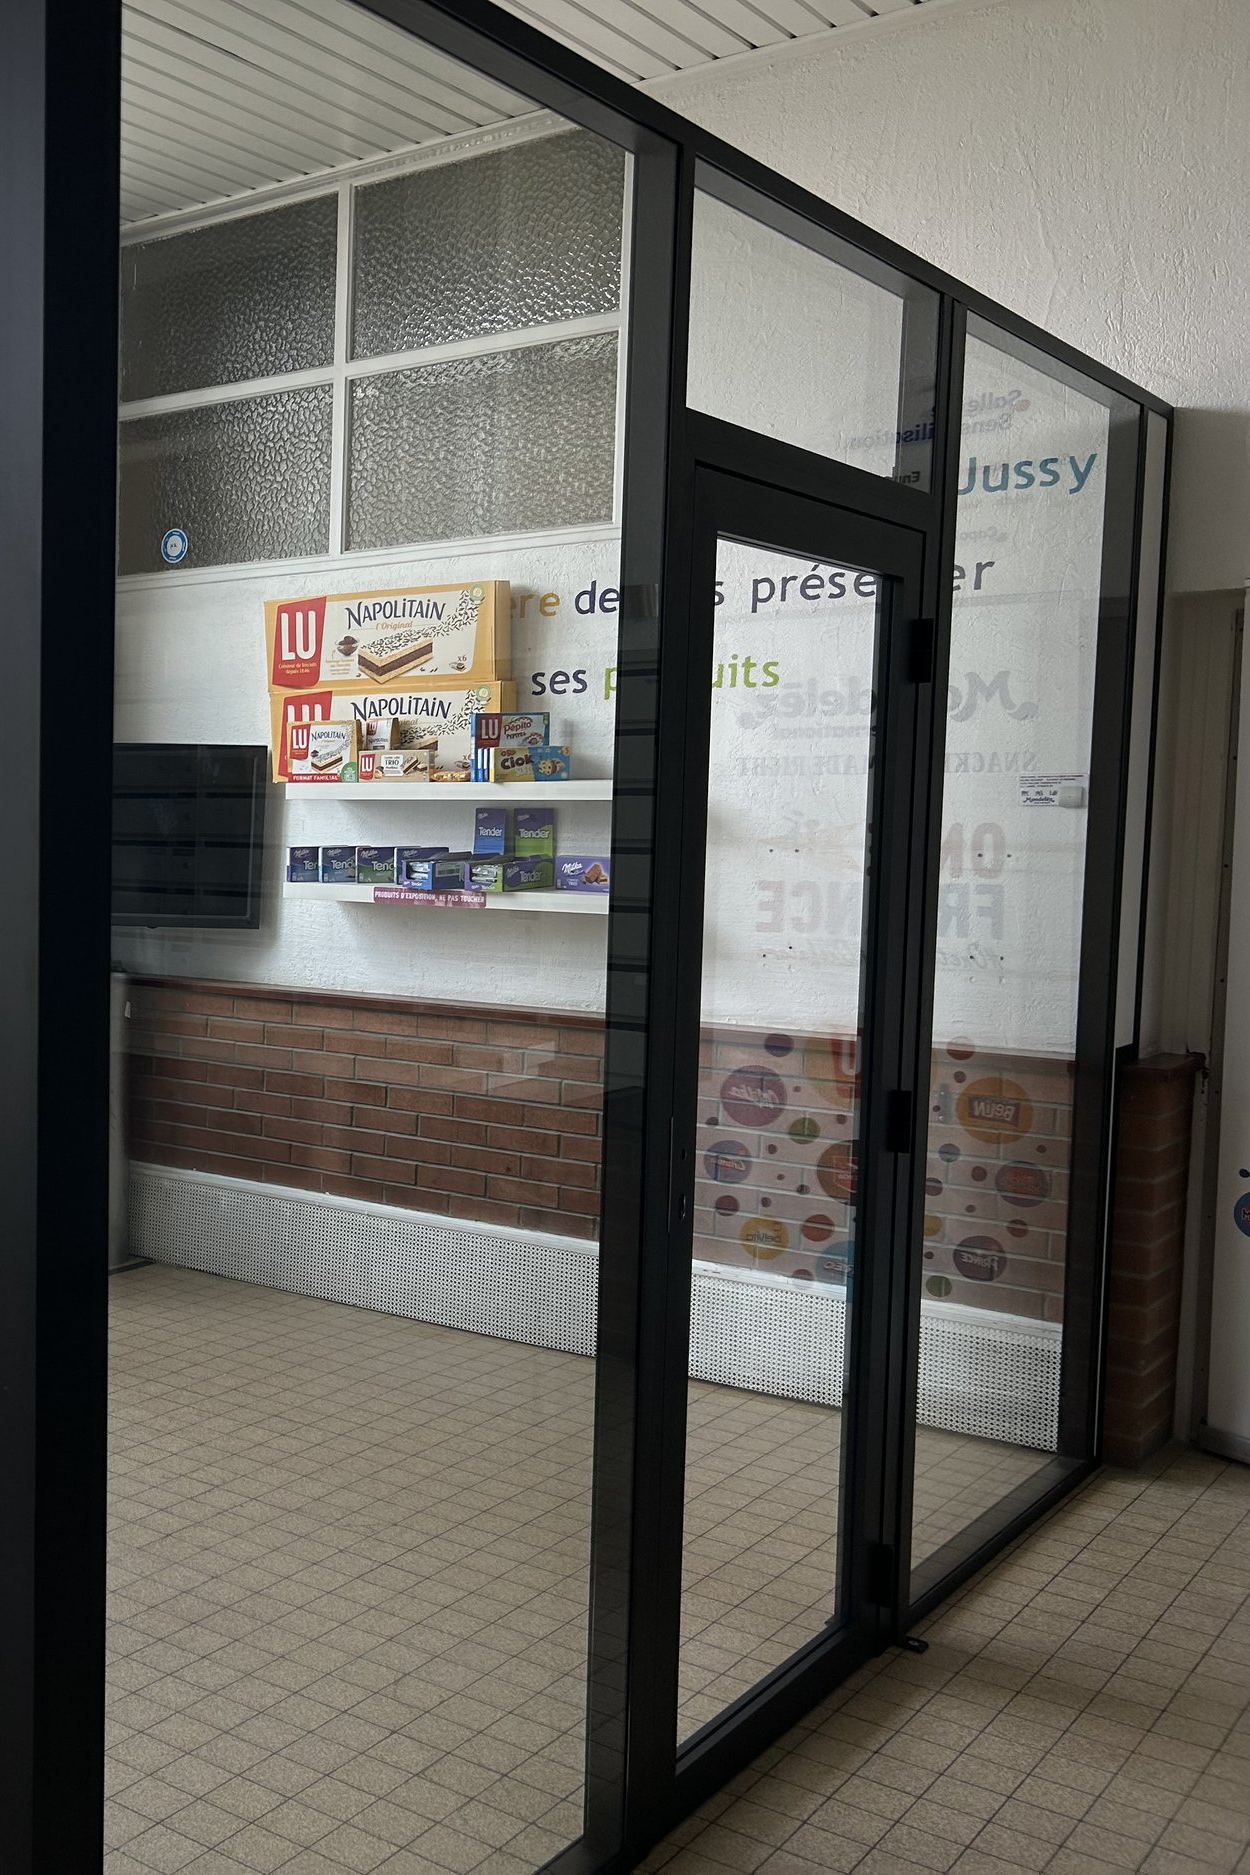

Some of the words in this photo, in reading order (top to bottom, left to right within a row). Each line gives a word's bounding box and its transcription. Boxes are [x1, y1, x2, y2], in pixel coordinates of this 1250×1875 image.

[957, 453, 1098, 495] Jussy
[752, 558, 995, 612] préseer
[574, 580, 620, 614] de
[280, 610, 316, 660] LU
[531, 668, 587, 696] ses
[293, 729, 308, 749] LU
[481, 719, 499, 739] LU
[361, 757, 373, 772] LU
[478, 826, 503, 837] Tender
[518, 828, 550, 839] Tender
[520, 870, 542, 883] Tender
[561, 861, 583, 874] Milka
[374, 890, 400, 899] PRODUITS
[447, 894, 459, 902] PAS
[459, 895, 485, 903] TOUCHER
